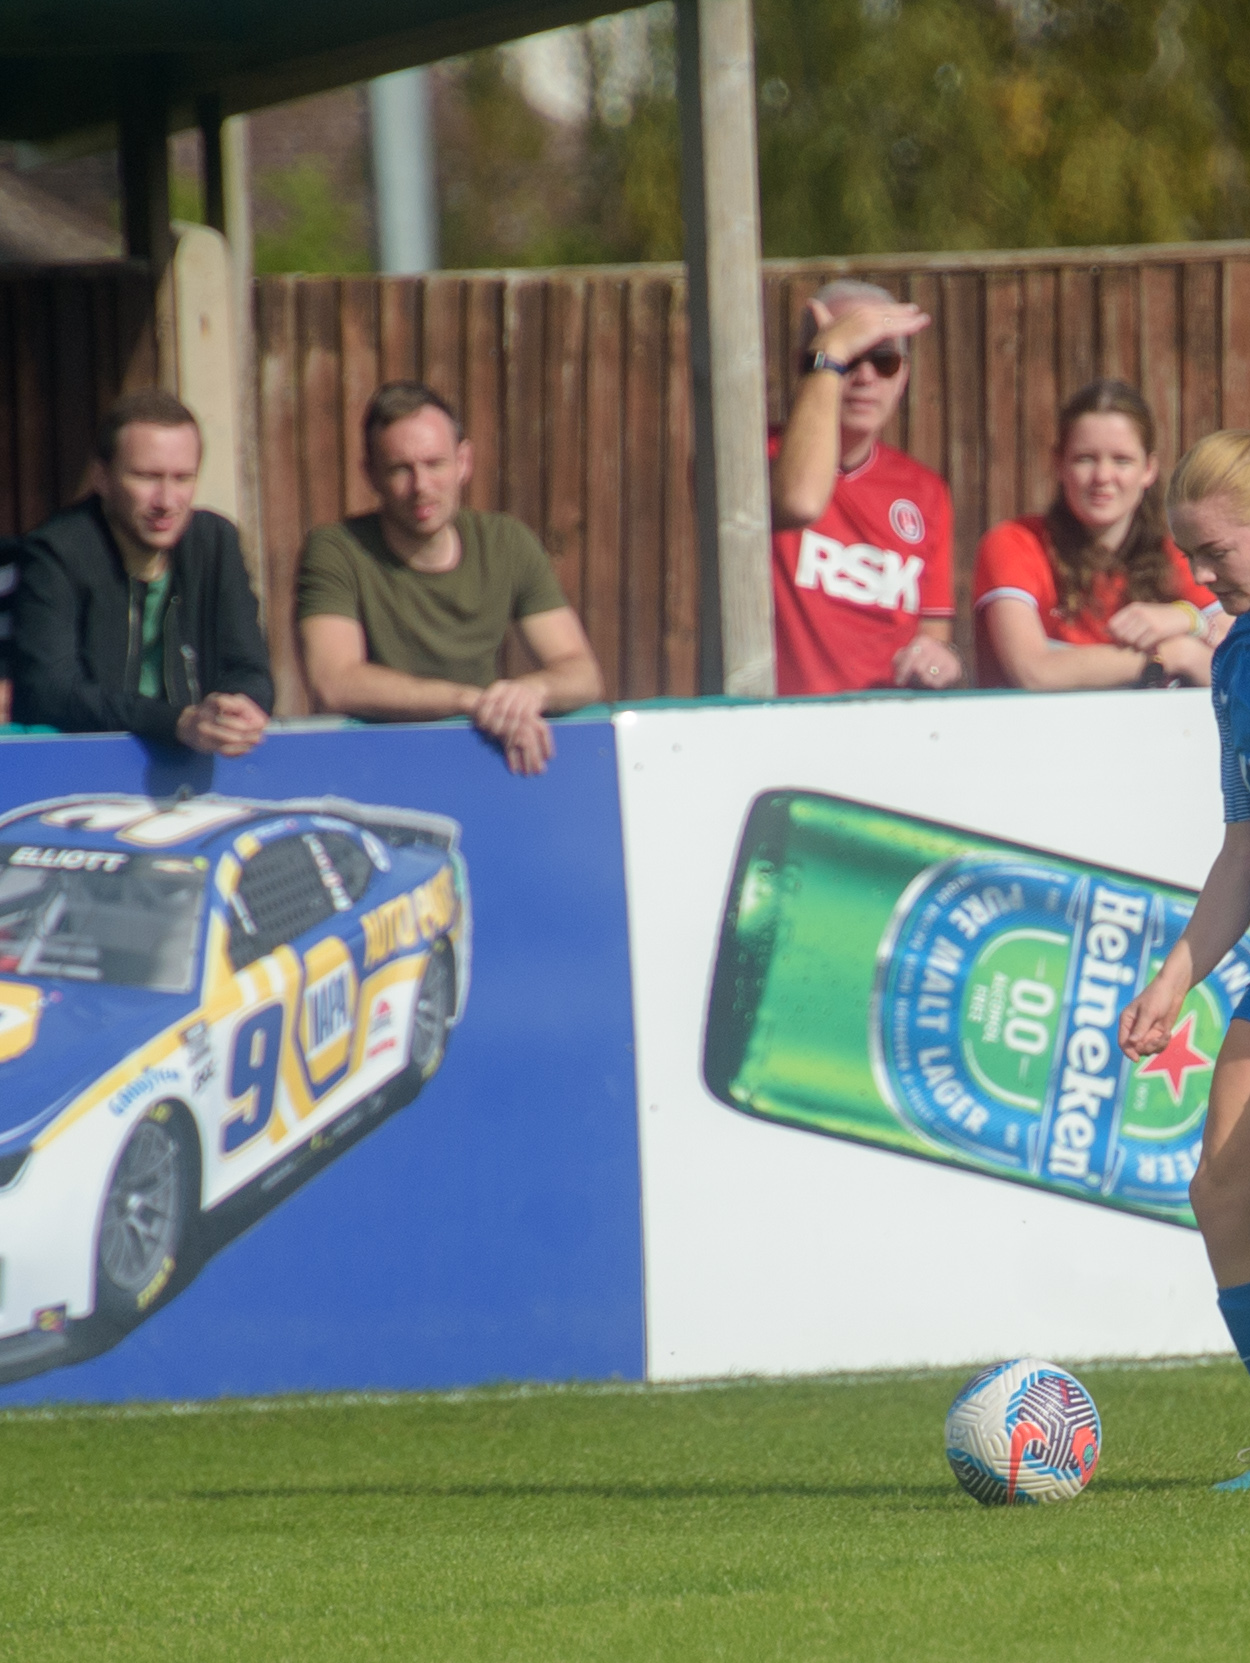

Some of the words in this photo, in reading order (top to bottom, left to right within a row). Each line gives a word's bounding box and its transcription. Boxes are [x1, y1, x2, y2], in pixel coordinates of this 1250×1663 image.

[795, 528, 925, 614] RSK
[9, 846, 129, 873] ELLIOTT
[948, 883, 1025, 940] PURE
[916, 934, 965, 1034] MALT
[1049, 886, 1147, 1178] Heineken
[221, 1001, 284, 1155] 9
[917, 1047, 990, 1134] LAGER
